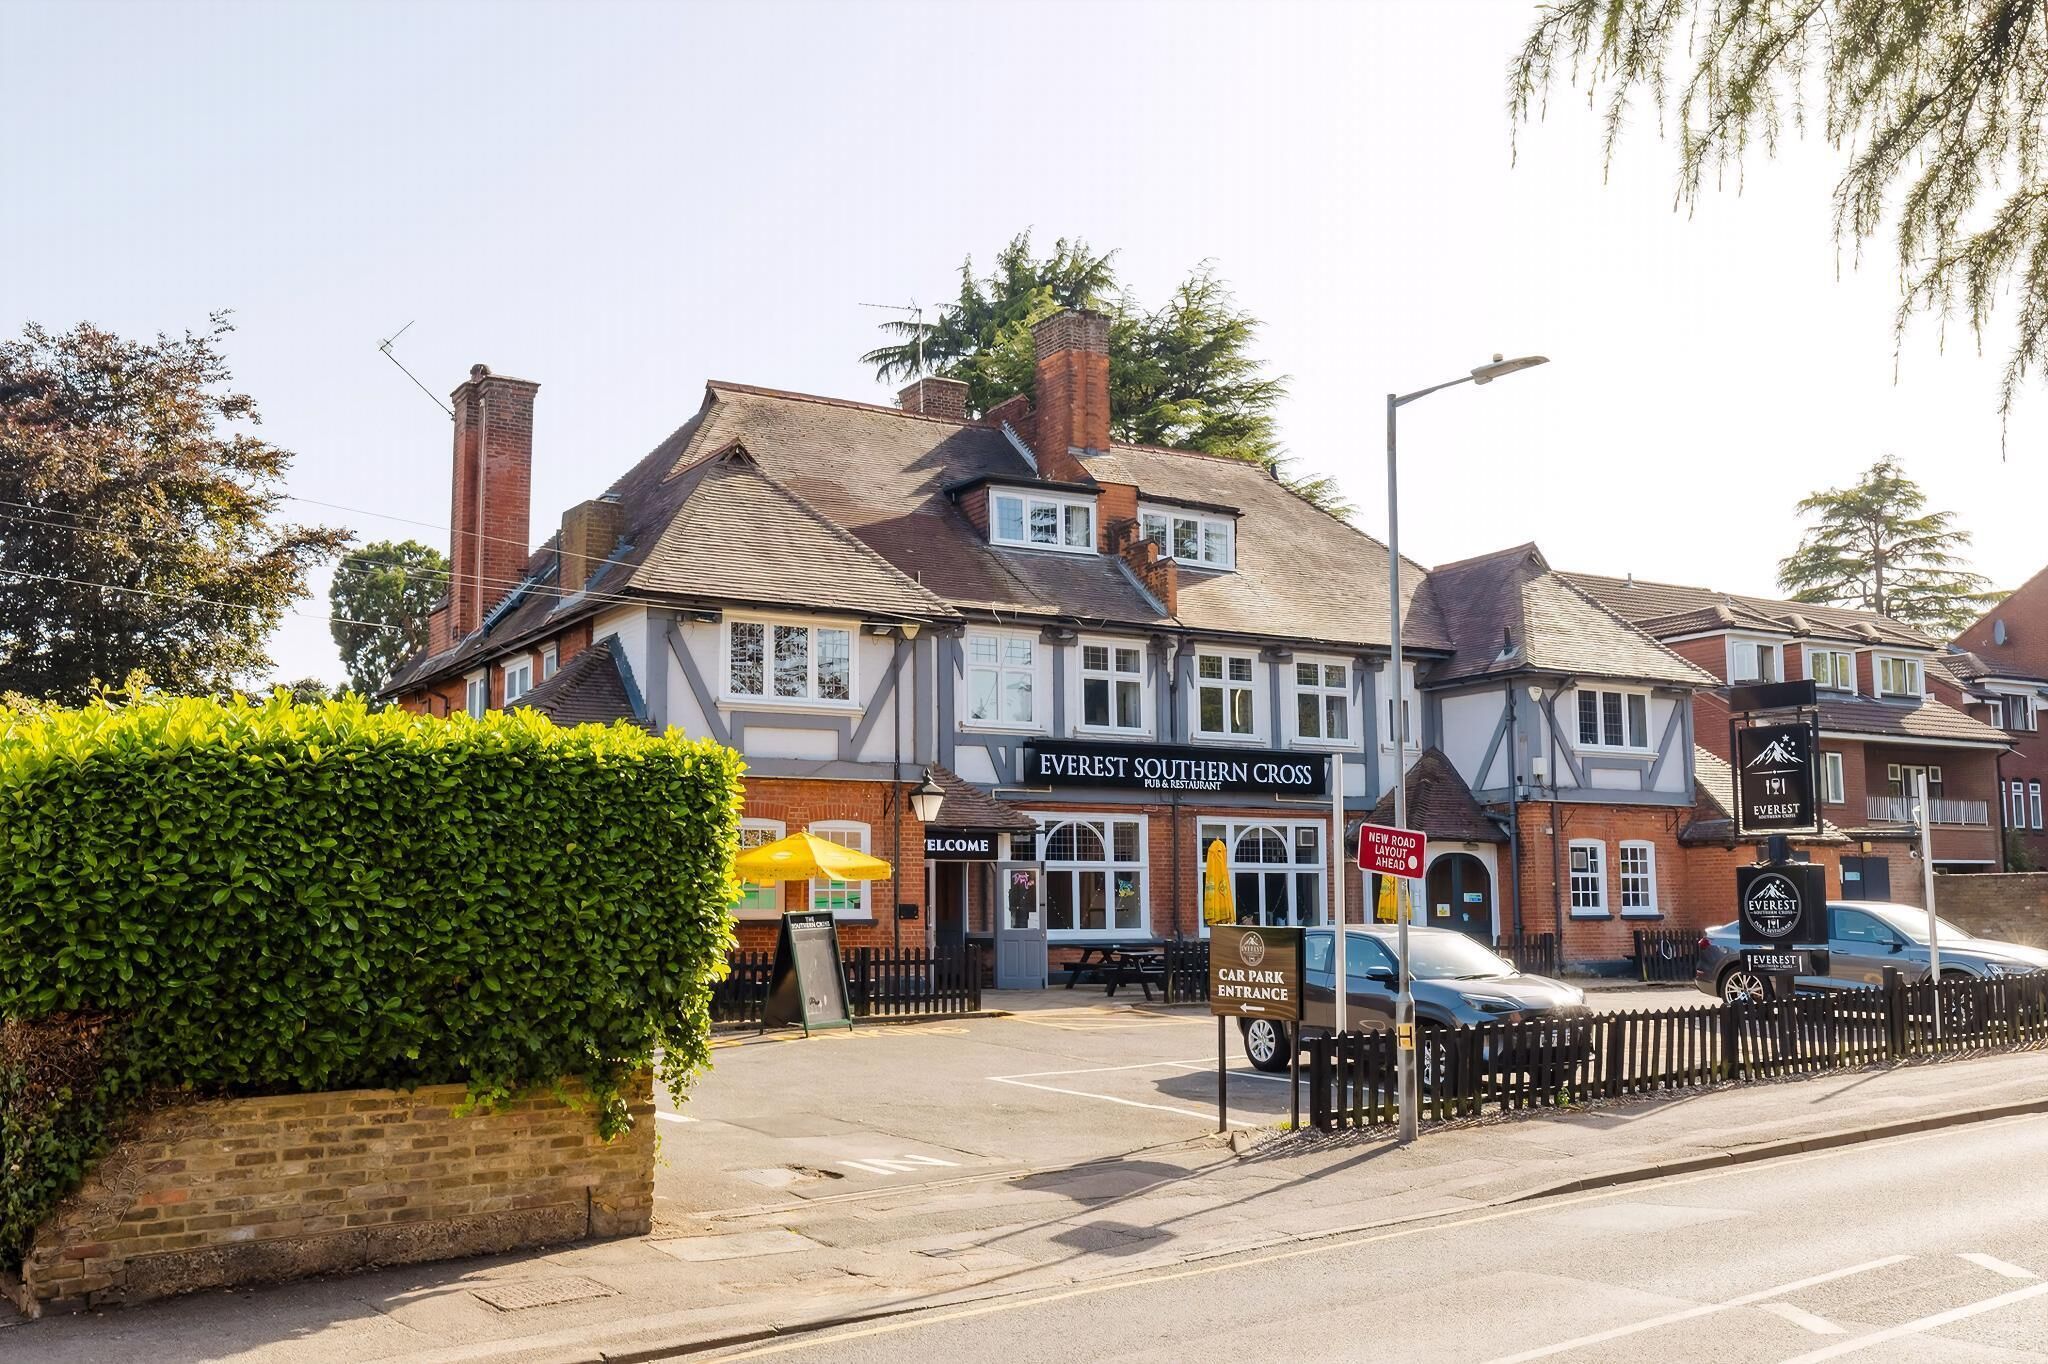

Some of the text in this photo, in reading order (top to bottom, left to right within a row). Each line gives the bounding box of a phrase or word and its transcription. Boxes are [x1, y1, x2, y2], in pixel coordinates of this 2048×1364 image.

[1040, 753, 1313, 785] EVEREST SOUTHERN CROSS
[1144, 778, 1222, 791] PUB & RESTAURANT
[1753, 803, 1801, 816] EVEREST
[923, 839, 989, 852] ELCOME
[1368, 831, 1416, 848] NEW ROAD
[1375, 844, 1408, 859] LAYOUT
[1375, 856, 1405, 871] AHEAD
[1748, 899, 1797, 911] EVEREST
[1753, 954, 1797, 965] EVEREST
[1218, 968, 1285, 984] CAR PARK
[1217, 984, 1289, 1001] ENTRANCE
[1397, 1025, 1413, 1048] H
